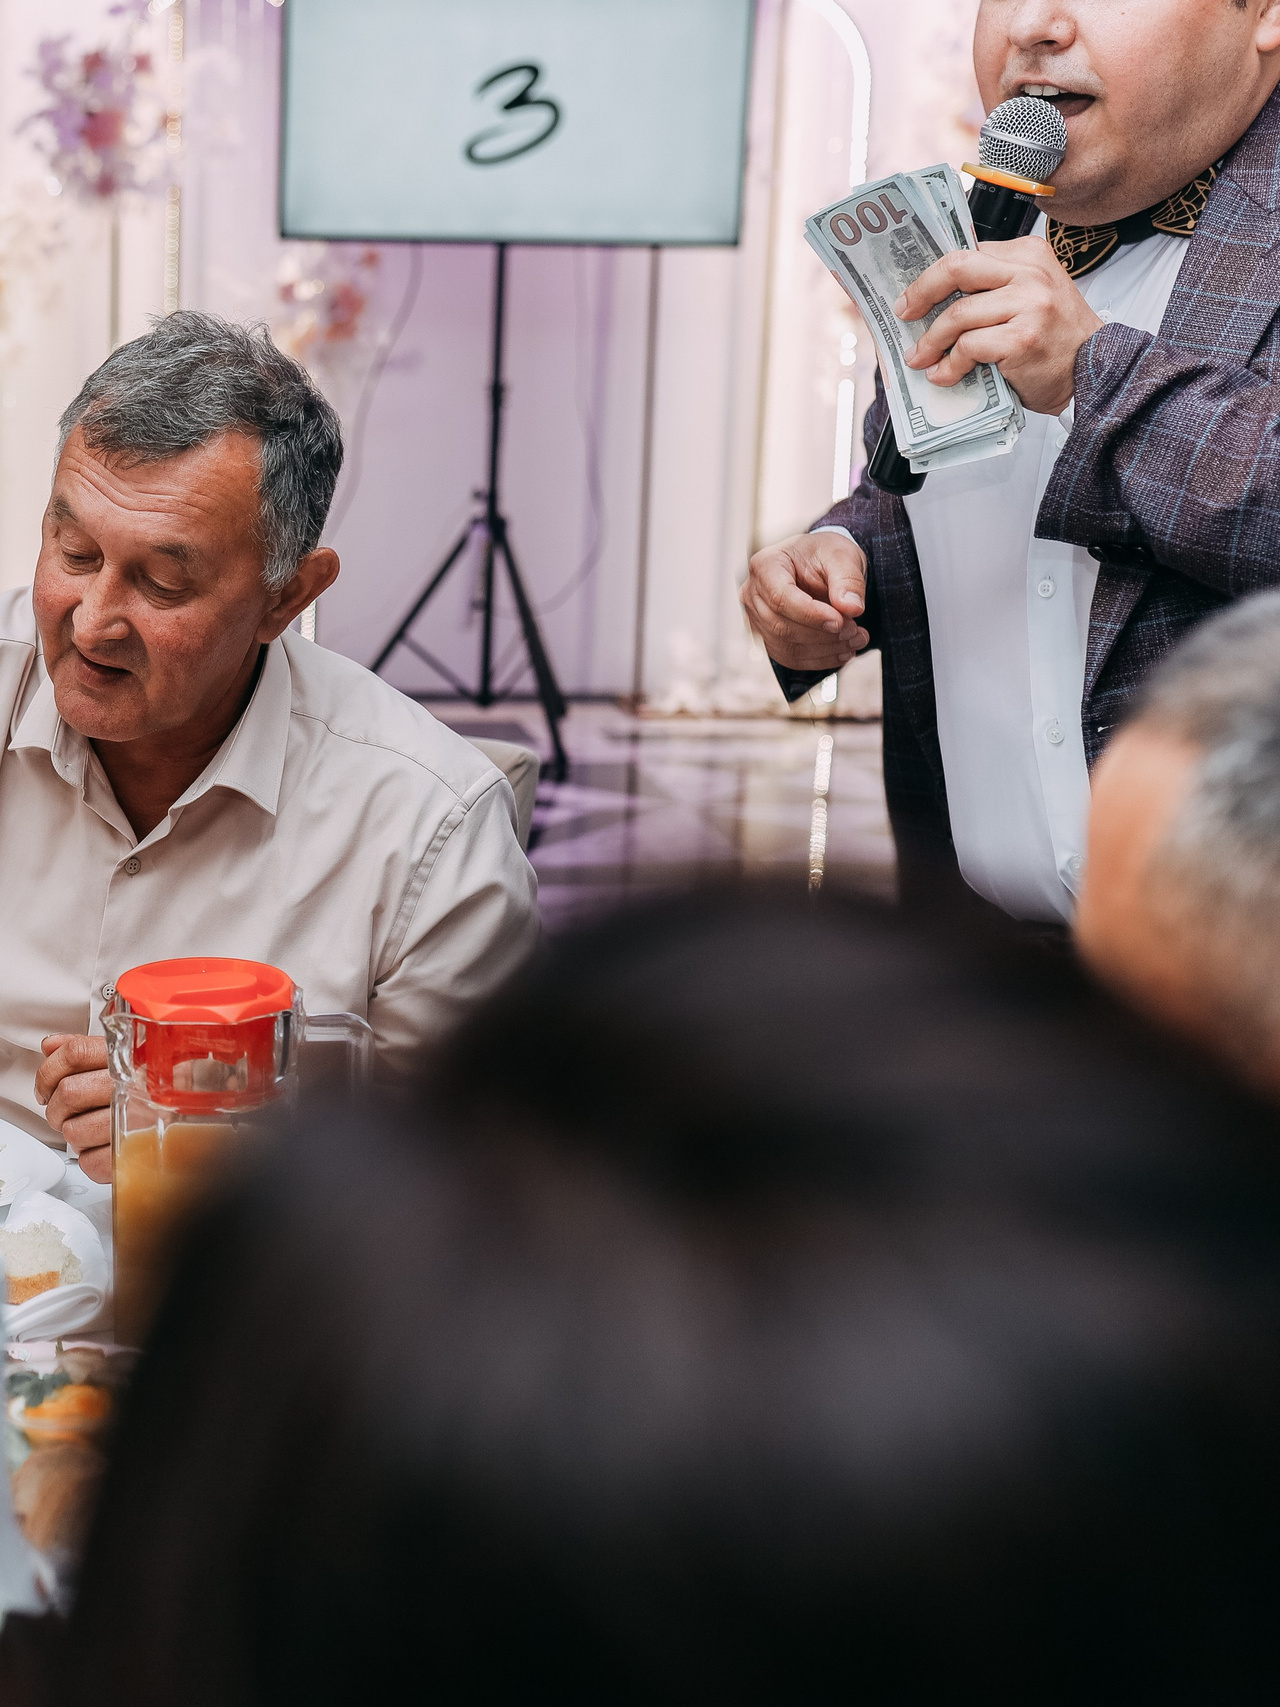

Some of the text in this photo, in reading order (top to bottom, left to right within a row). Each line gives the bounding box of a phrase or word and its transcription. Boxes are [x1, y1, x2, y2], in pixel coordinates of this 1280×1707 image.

[463, 63, 561, 166] 3
[829, 193, 908, 246] 100
[1013, 192, 1033, 204] SHUR
